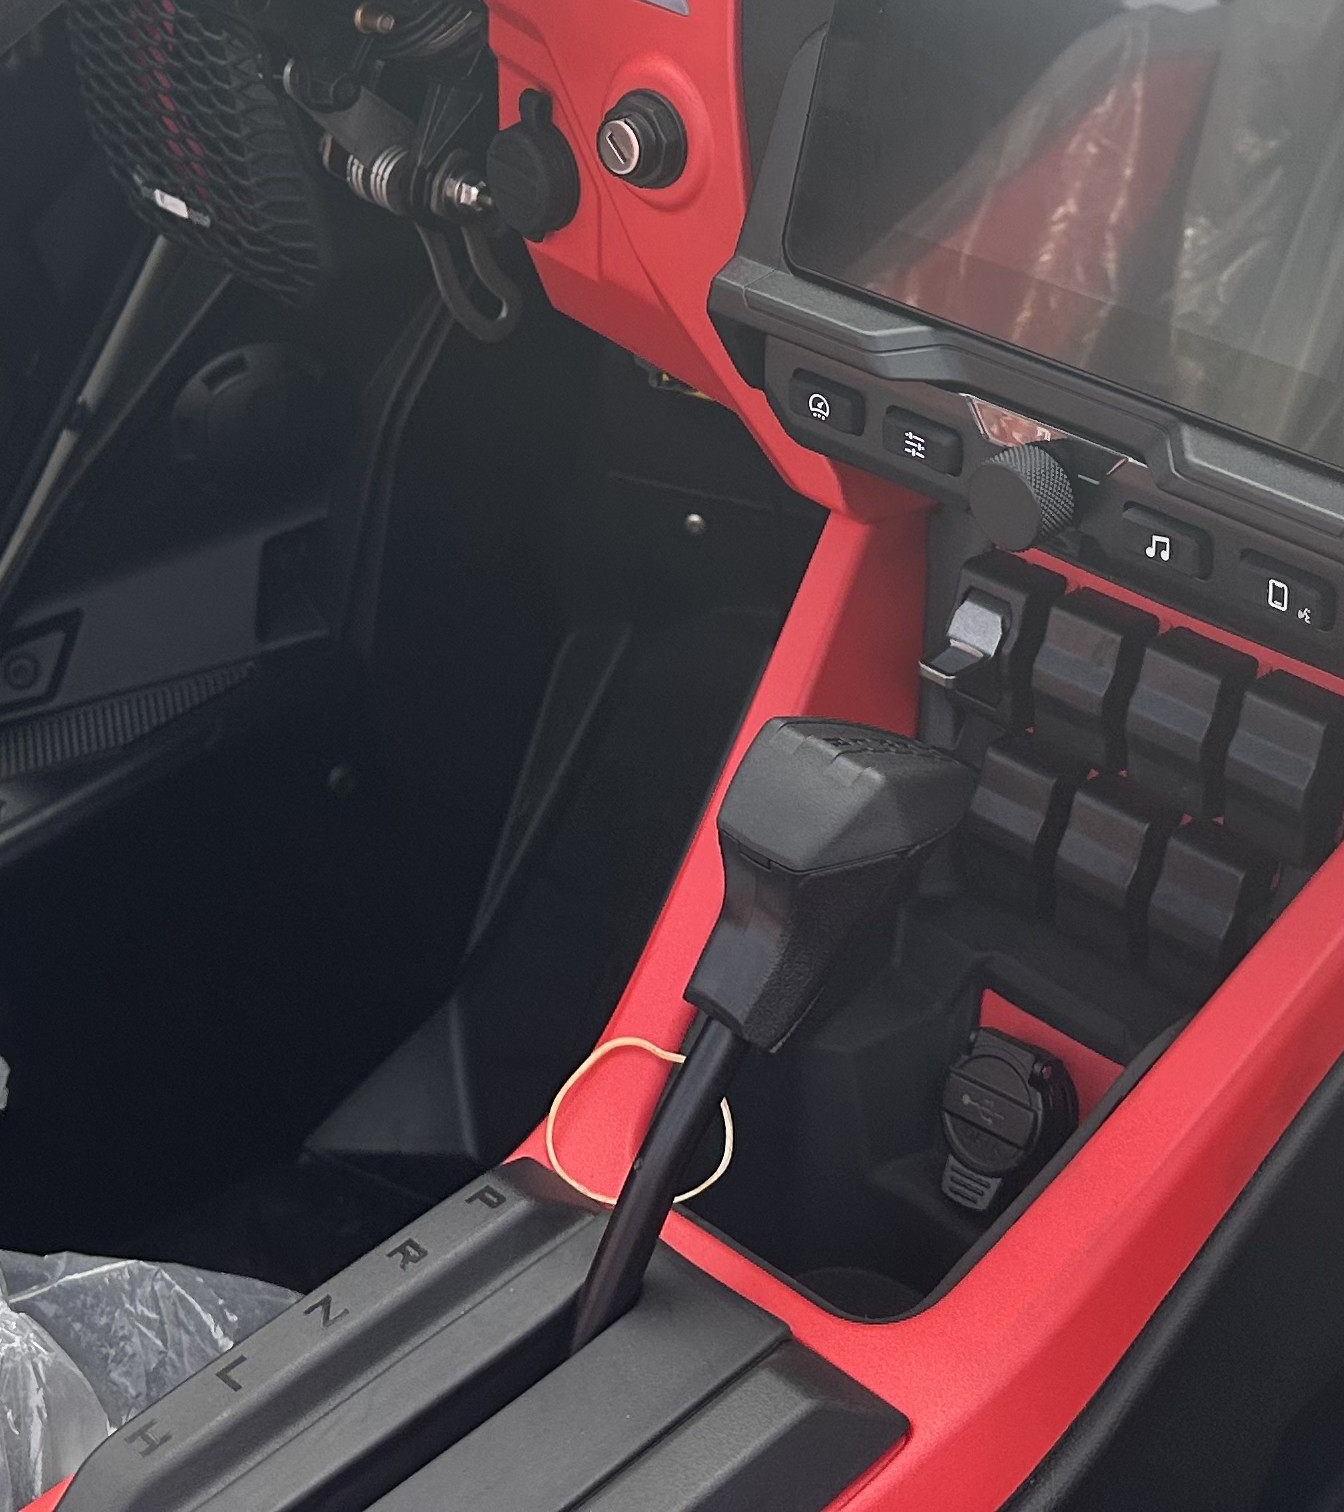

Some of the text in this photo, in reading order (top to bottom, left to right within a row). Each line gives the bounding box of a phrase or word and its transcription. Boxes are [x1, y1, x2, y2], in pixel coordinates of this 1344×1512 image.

[465, 1184, 507, 1210] P
[386, 1237, 428, 1271] R
[303, 1294, 349, 1329] N
[215, 1354, 248, 1392] L
[124, 1419, 172, 1458] H
